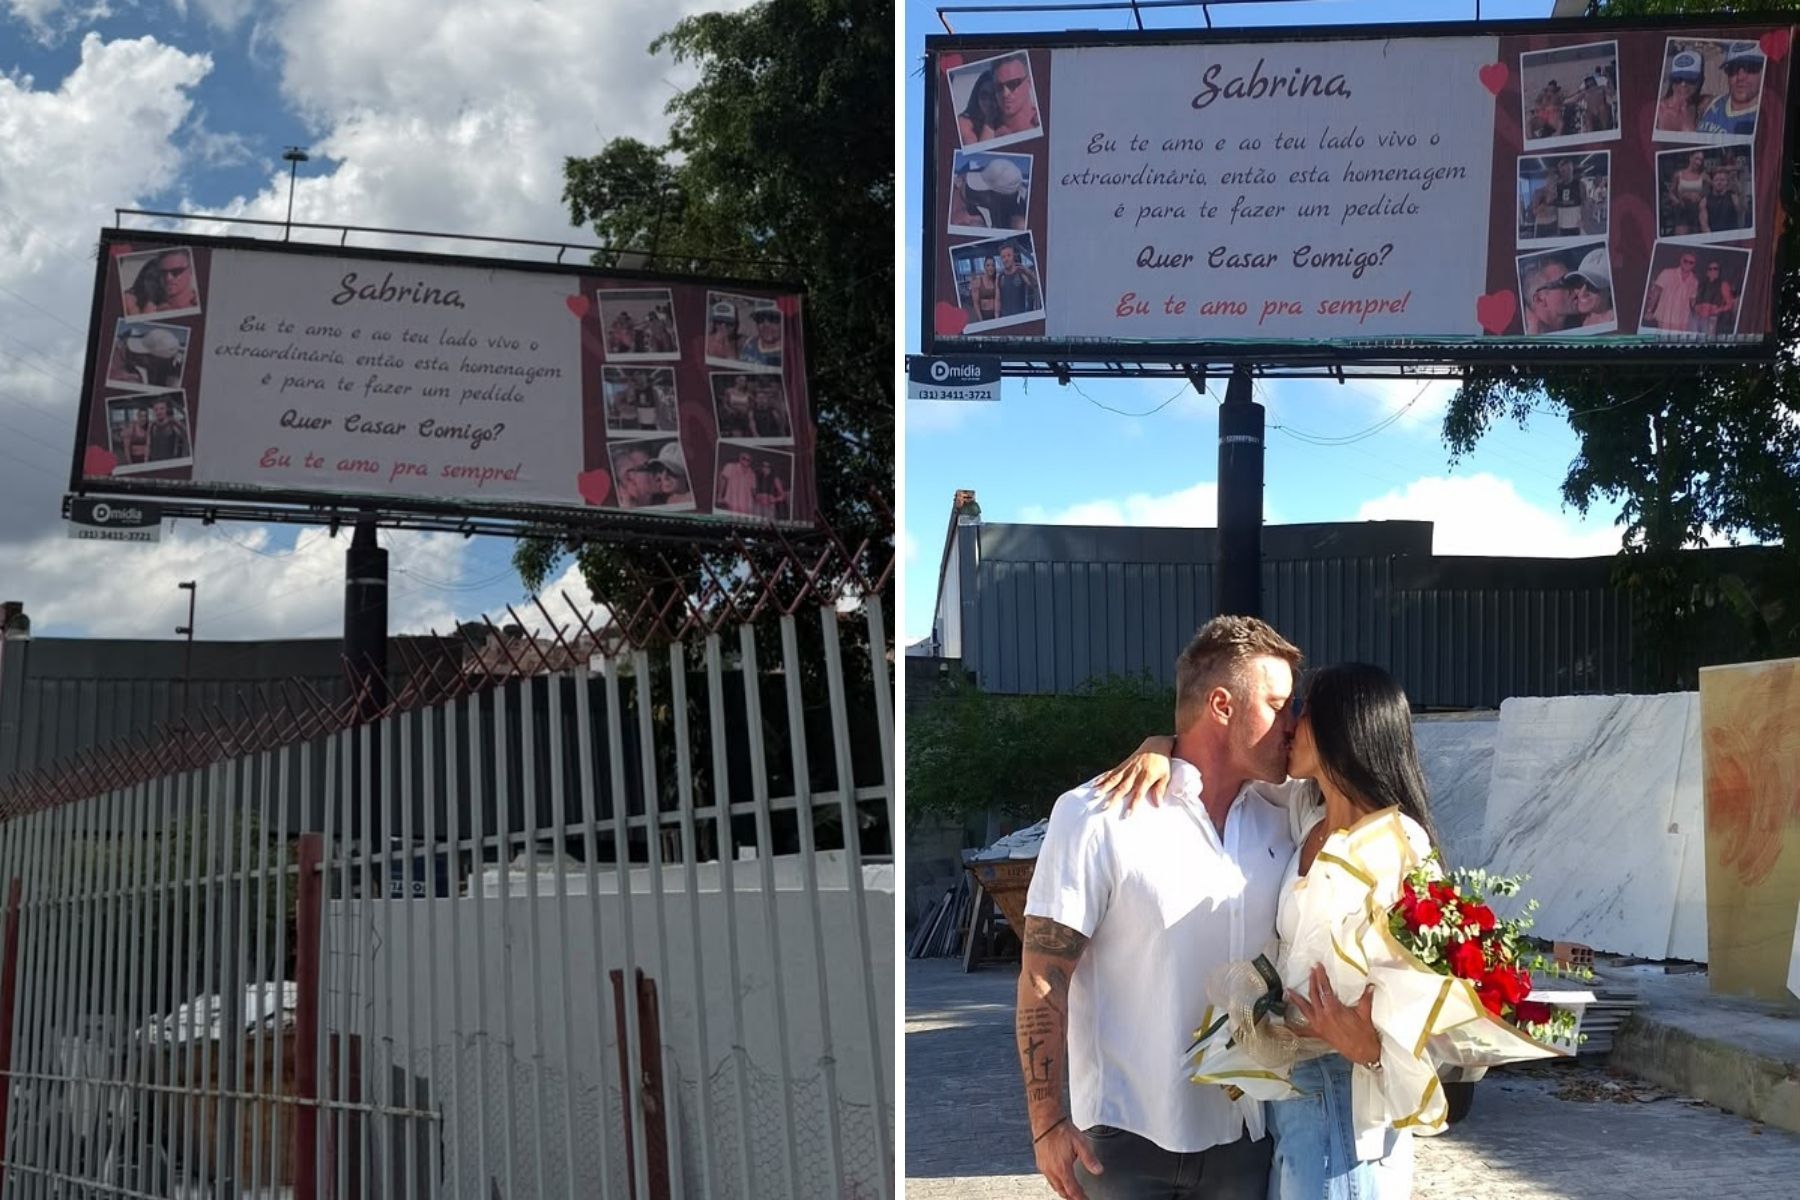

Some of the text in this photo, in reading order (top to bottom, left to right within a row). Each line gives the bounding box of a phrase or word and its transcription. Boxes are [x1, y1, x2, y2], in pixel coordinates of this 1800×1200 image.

[1191, 58, 1352, 110] Sabrina,
[1087, 126, 1440, 155] Eu te amo e ao teu lado vivo o
[1220, 168, 1276, 185] então
[1289, 165, 1331, 184] esta
[1343, 160, 1467, 191] homenagem
[1114, 203, 1125, 219] é
[1135, 205, 1186, 228] para
[1200, 201, 1218, 219] te
[1230, 195, 1285, 225] fazer
[1297, 204, 1330, 218] um
[1136, 243, 1394, 279] Quer Casar Comigo?
[331, 271, 466, 309] Sabrina,
[1115, 290, 1412, 326] Eu te amo pra sempre!
[239, 315, 539, 351] Eu te amo e ao teu lado vivo o
[356, 349, 405, 370] então
[414, 356, 450, 372] esta
[459, 355, 562, 385] homenagem
[279, 375, 326, 394] para
[337, 376, 355, 392] te
[363, 373, 413, 399] fazer
[421, 385, 451, 399] um
[919, 390, 992, 400] (31) 3411-3721
[280, 408, 506, 451] Quer Casar Comigo?
[258, 447, 523, 489] Eu te amo pra sempre!
